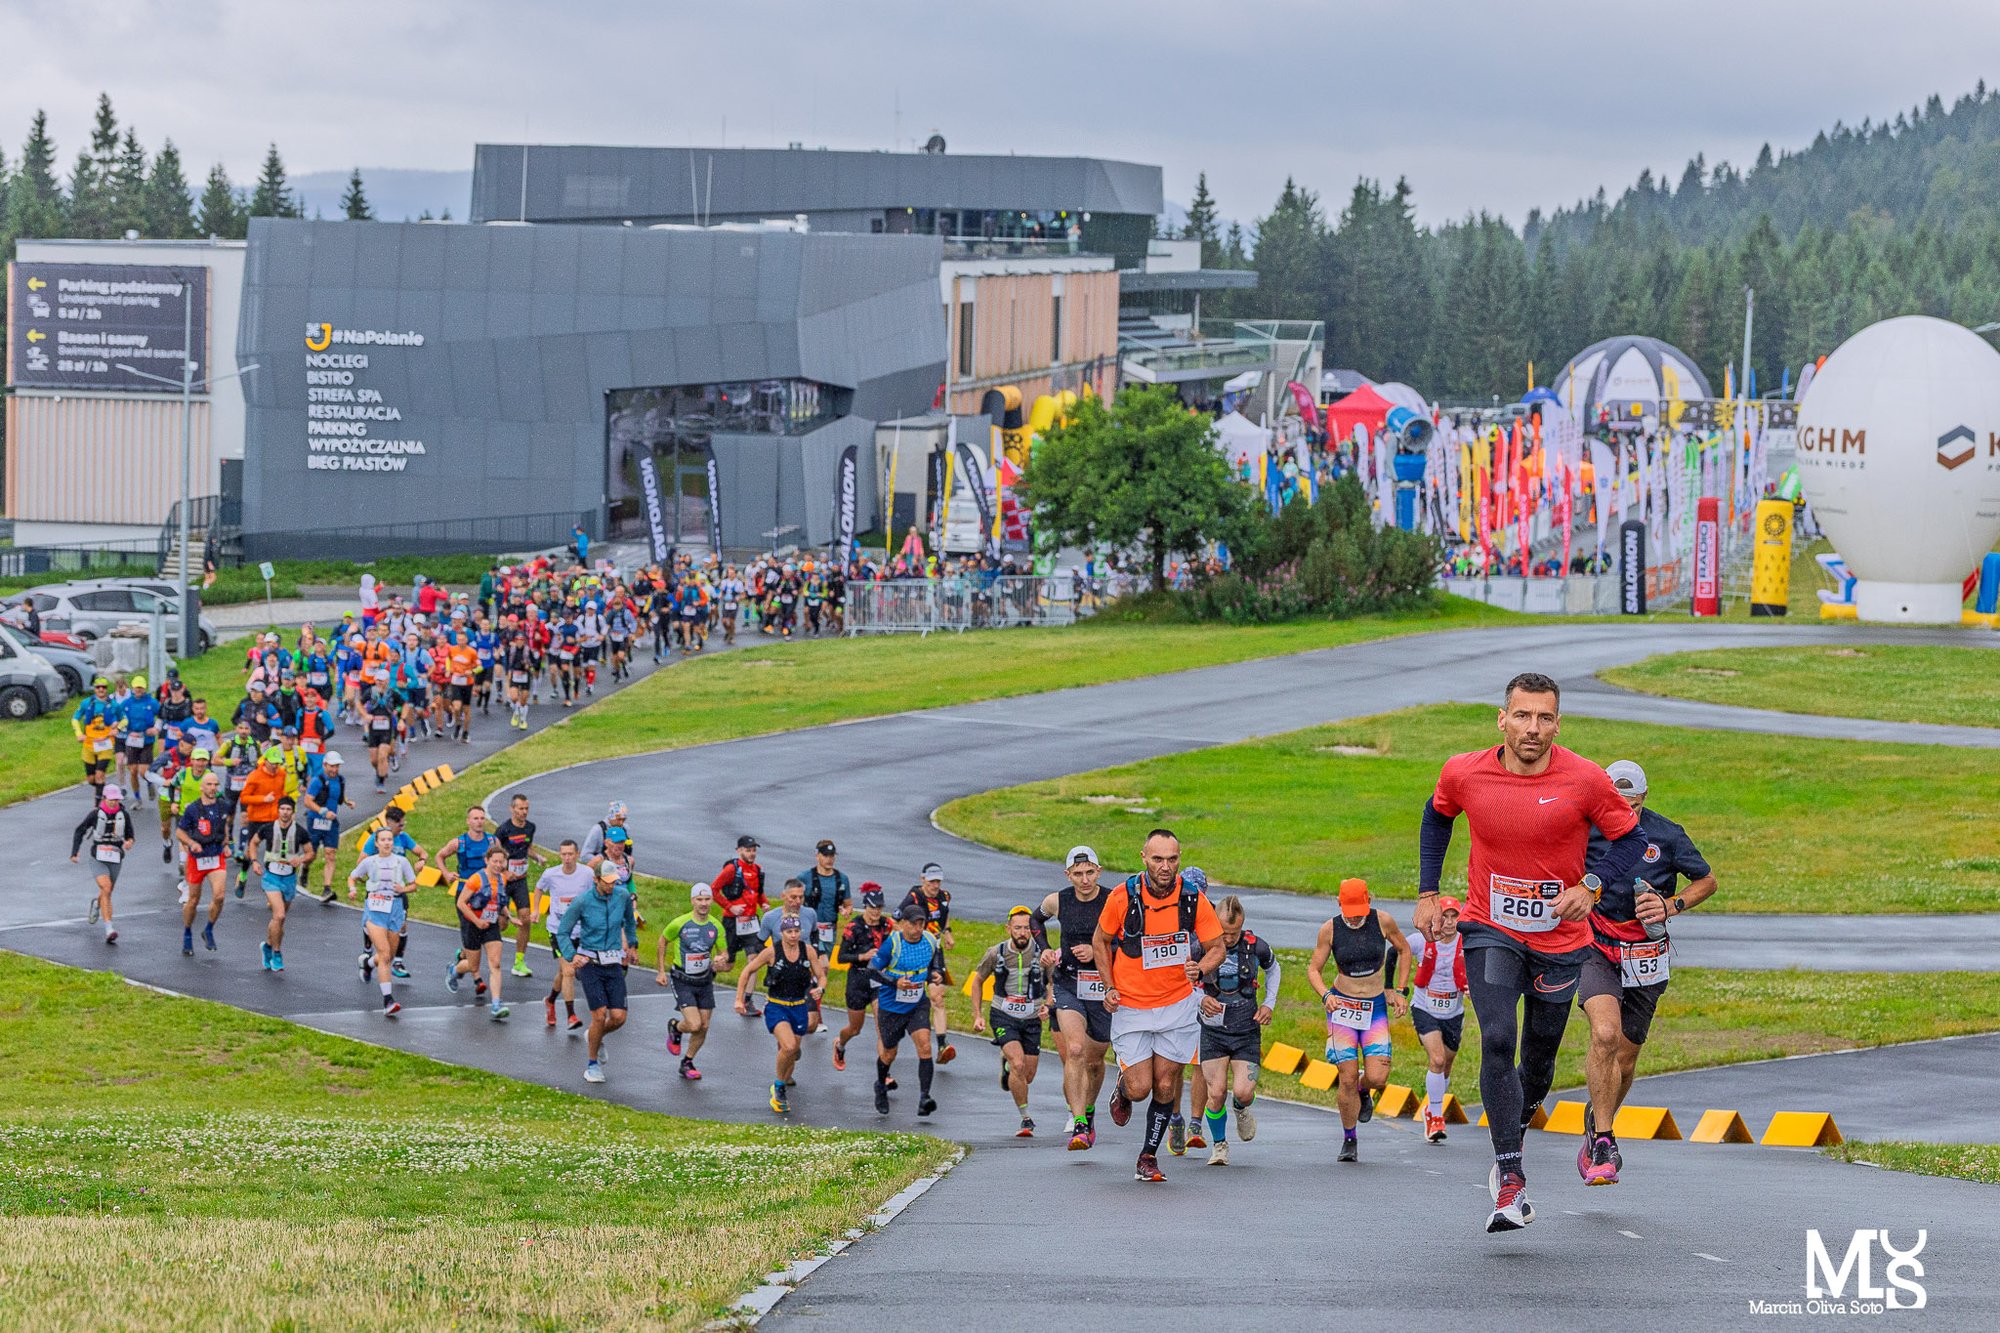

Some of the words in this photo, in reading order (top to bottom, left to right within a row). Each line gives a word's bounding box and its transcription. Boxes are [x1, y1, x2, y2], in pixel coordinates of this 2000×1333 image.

[58, 279, 110, 295] Parking
[332, 329, 425, 347] #NaPolanie
[305, 353, 369, 369] NOCLEGI
[306, 370, 355, 386] BISTRO
[307, 387, 356, 403] STREFA
[357, 388, 383, 404] SPA
[307, 404, 401, 421] RESTAURACJA
[307, 420, 368, 437] PARKING
[307, 437, 426, 455] WYPOŻYCZALNIA
[307, 454, 341, 470] BIEG
[342, 454, 408, 472] PIASTÓW
[1625, 529, 1639, 614] SALOMON
[1502, 896, 1544, 919] 260
[1151, 945, 1178, 959] 190
[1639, 958, 1658, 975] 53
[1007, 1003, 1027, 1013] 320
[1431, 998, 1451, 1009] 189
[1339, 1007, 1363, 1022] 275
